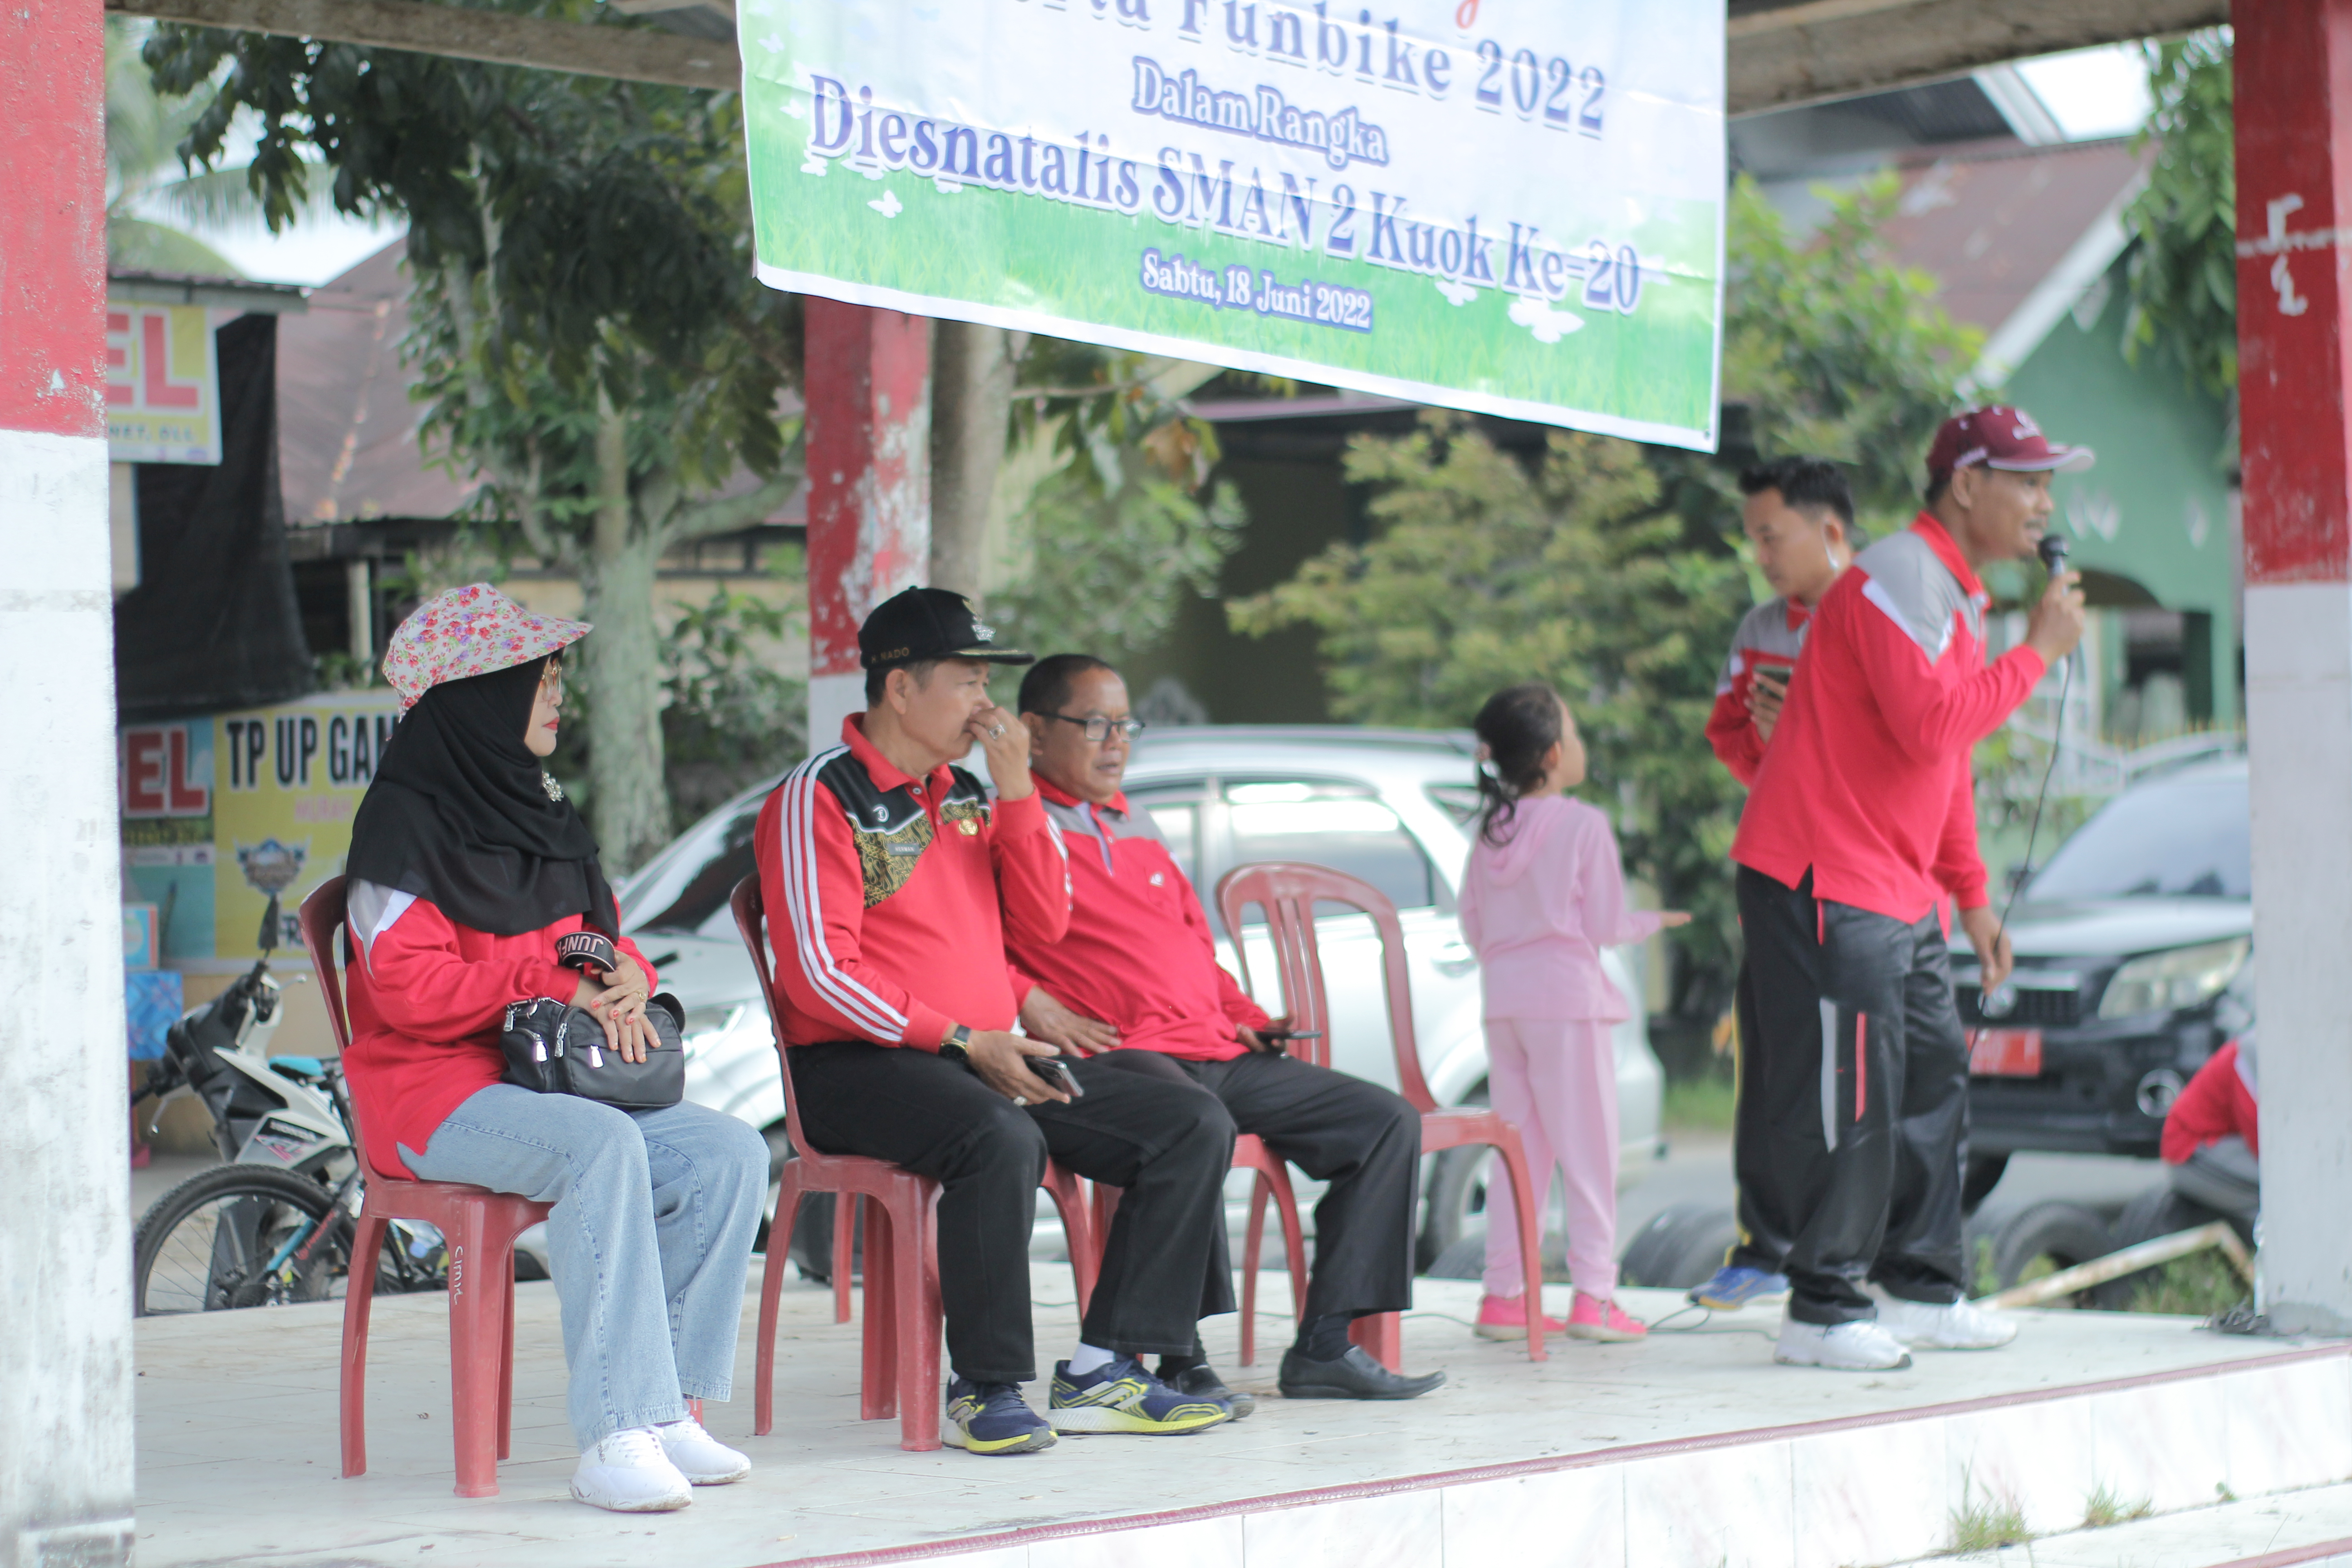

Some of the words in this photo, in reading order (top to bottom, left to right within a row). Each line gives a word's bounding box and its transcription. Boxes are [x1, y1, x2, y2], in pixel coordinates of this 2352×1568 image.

[1133, 58, 1253, 132] Dalam
[1256, 86, 1387, 167] Rangka
[1475, 39, 1604, 132] 2022
[810, 74, 1140, 209] Diesnatalis
[1152, 147, 1317, 245] SMAN
[1328, 183, 1356, 253] 2
[1367, 191, 1495, 284] Kuok
[1504, 221, 1639, 309] Ke-20
[1142, 252, 1222, 306] Sabtu,
[1226, 269, 1251, 306] 18
[1255, 274, 1312, 318] Juni
[1316, 286, 1372, 330] 2022
[277, 715, 317, 786] UP
